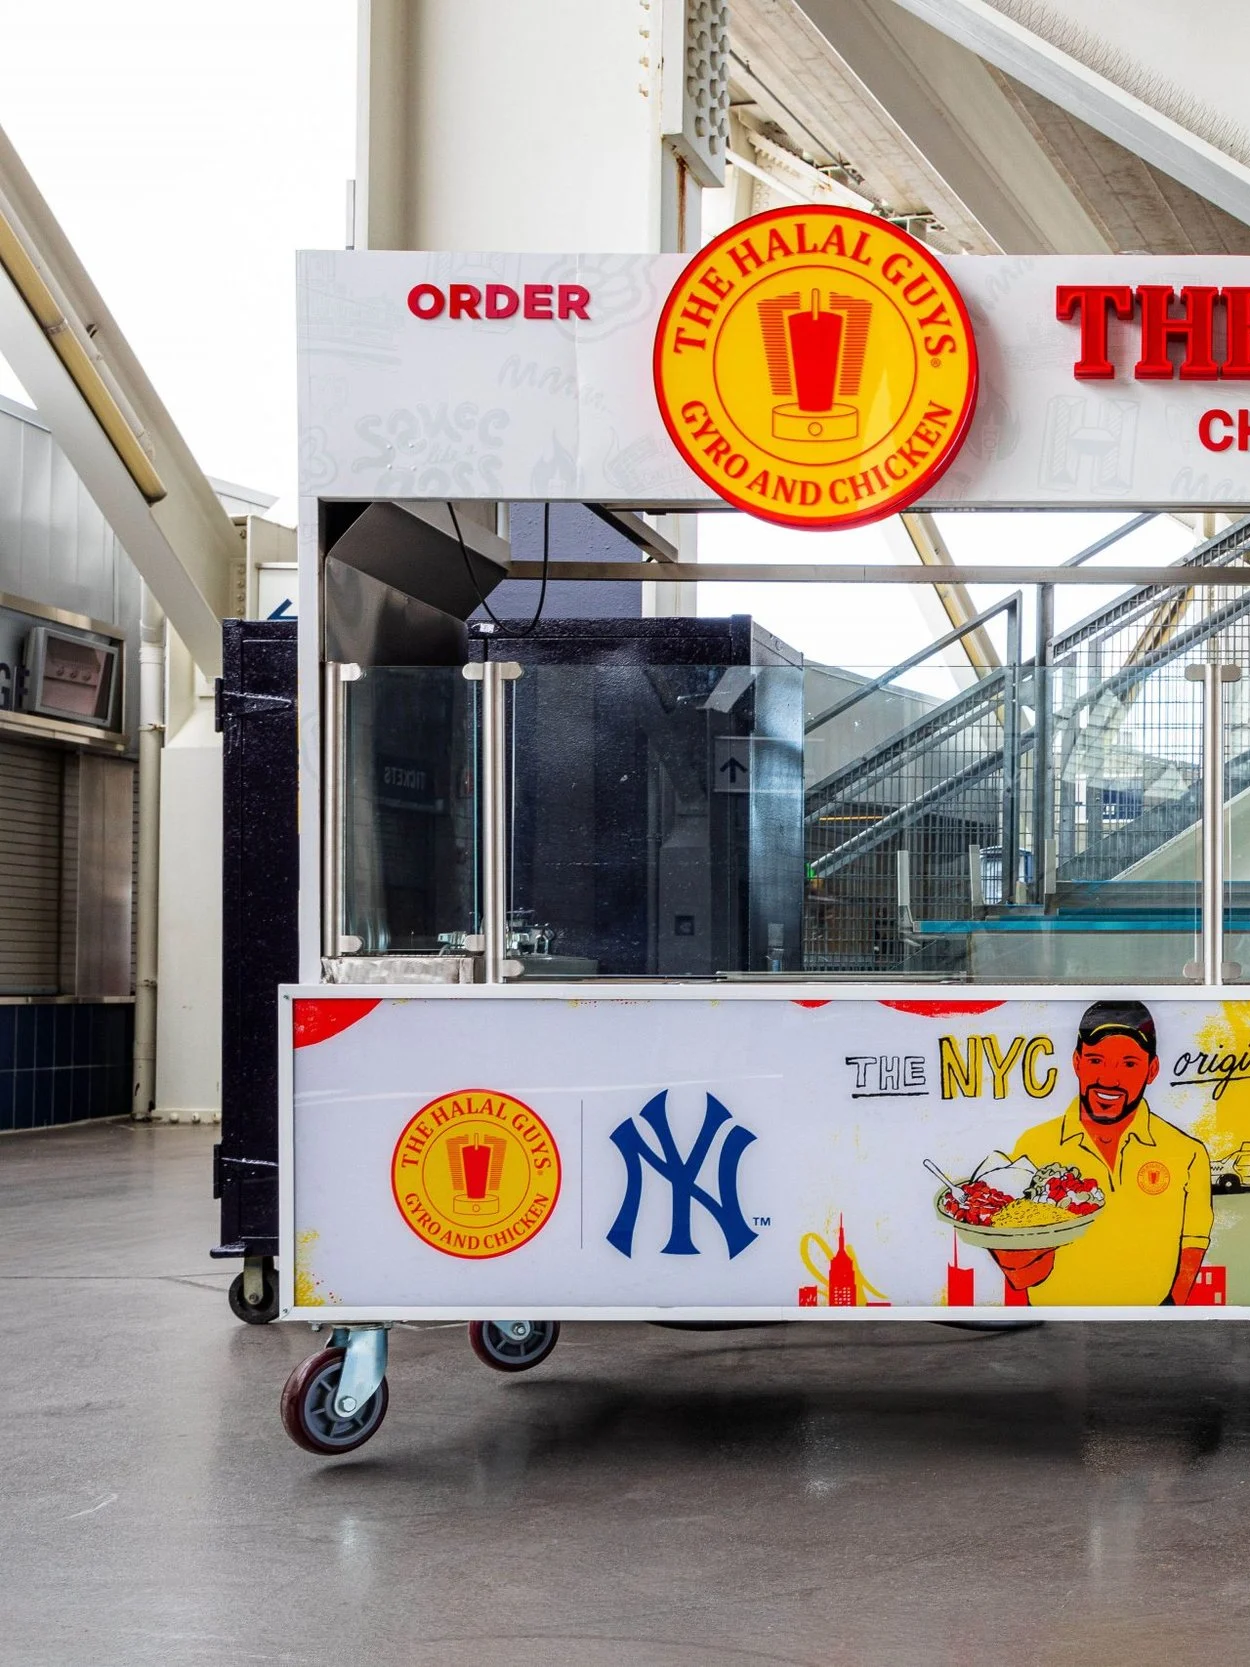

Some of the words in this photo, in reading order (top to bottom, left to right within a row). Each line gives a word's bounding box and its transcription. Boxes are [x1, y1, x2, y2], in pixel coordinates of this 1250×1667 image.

[408, 284, 589, 320] ORDER
[673, 267, 735, 354] THE
[726, 223, 872, 277] HALAL
[681, 400, 749, 480] GYRO
[746, 470, 821, 506] AND
[829, 401, 953, 506] CHICKEN
[845, 1055, 927, 1091] THE
[938, 1034, 1058, 1100] NYC
[401, 1121, 434, 1169] THE
[430, 1097, 508, 1127] HALAL
[606, 1089, 760, 1261] NY
[405, 1192, 441, 1236] GYRO
[439, 1230, 480, 1250] AND
[483, 1193, 550, 1249] CHICKEN
